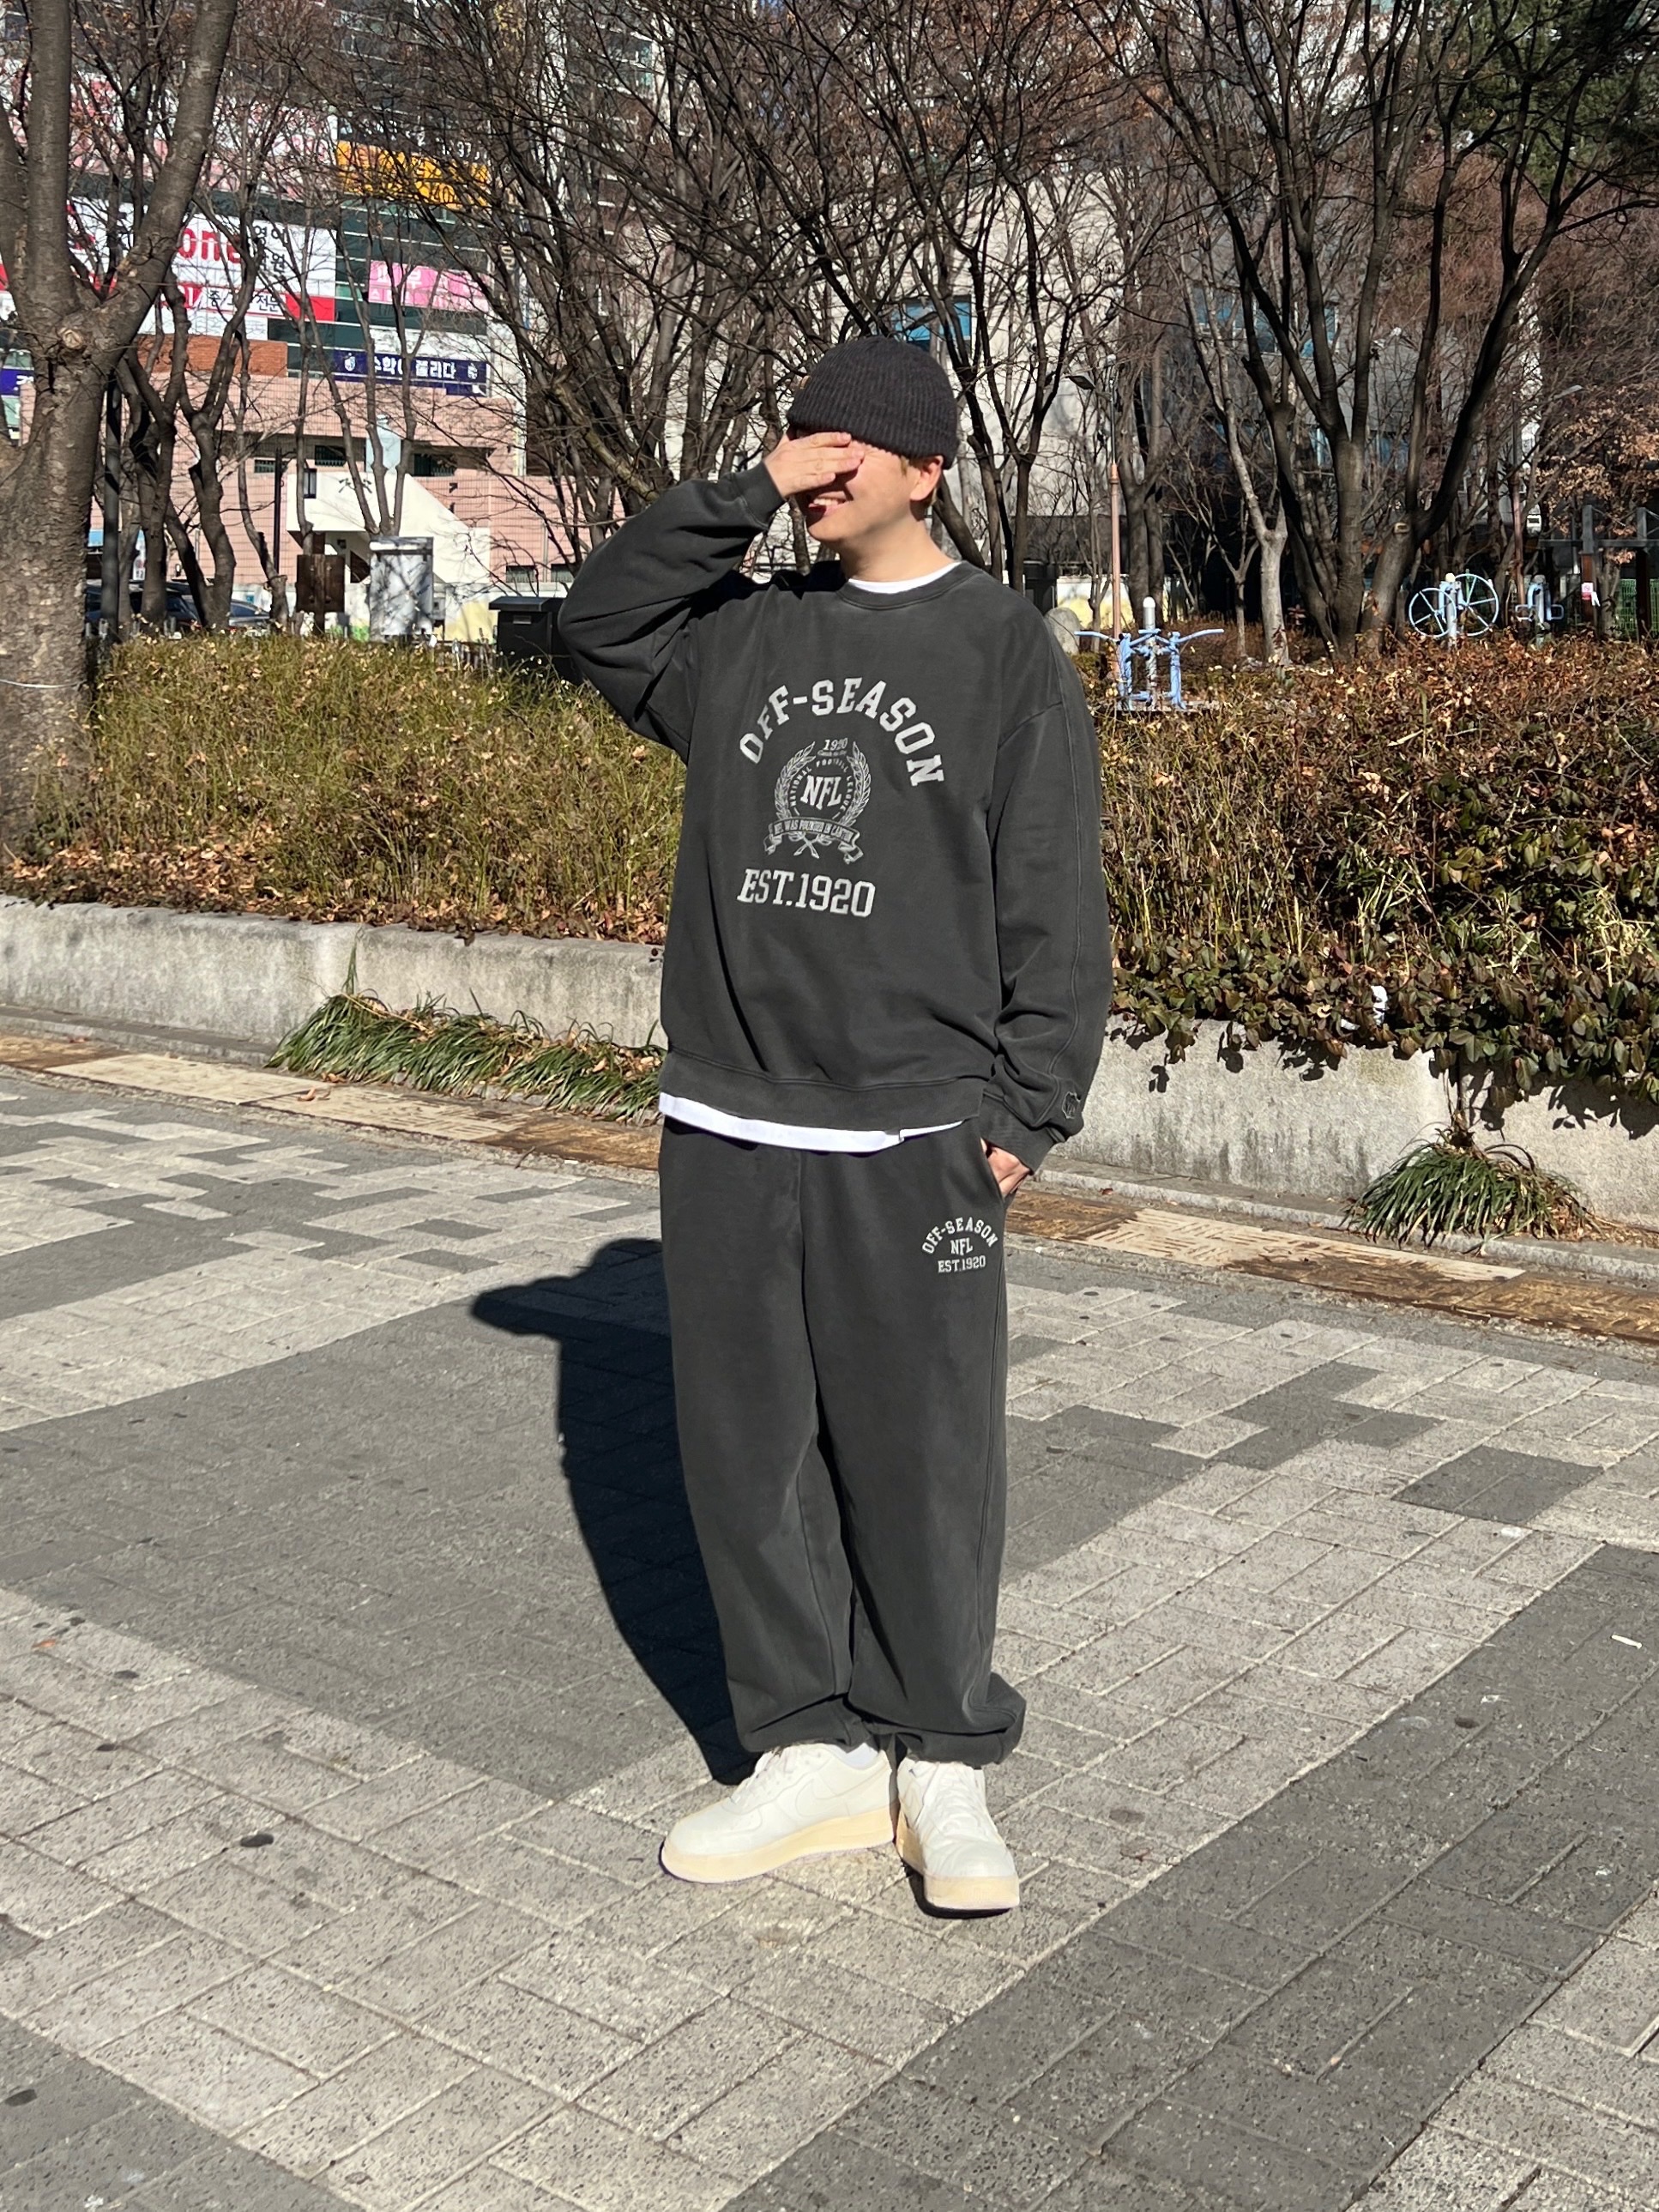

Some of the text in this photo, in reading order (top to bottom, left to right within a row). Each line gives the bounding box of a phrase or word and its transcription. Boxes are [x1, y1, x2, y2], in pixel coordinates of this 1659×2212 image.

[375, 355, 403, 376] 수학
[739, 677, 944, 786] OFF-SEASON
[800, 775, 842, 810] NFL
[737, 868, 876, 917] EST.1920
[922, 1217, 998, 1254] OFF-SEASON
[950, 1237, 973, 1256] NFL
[938, 1255, 986, 1273] EST.1920
